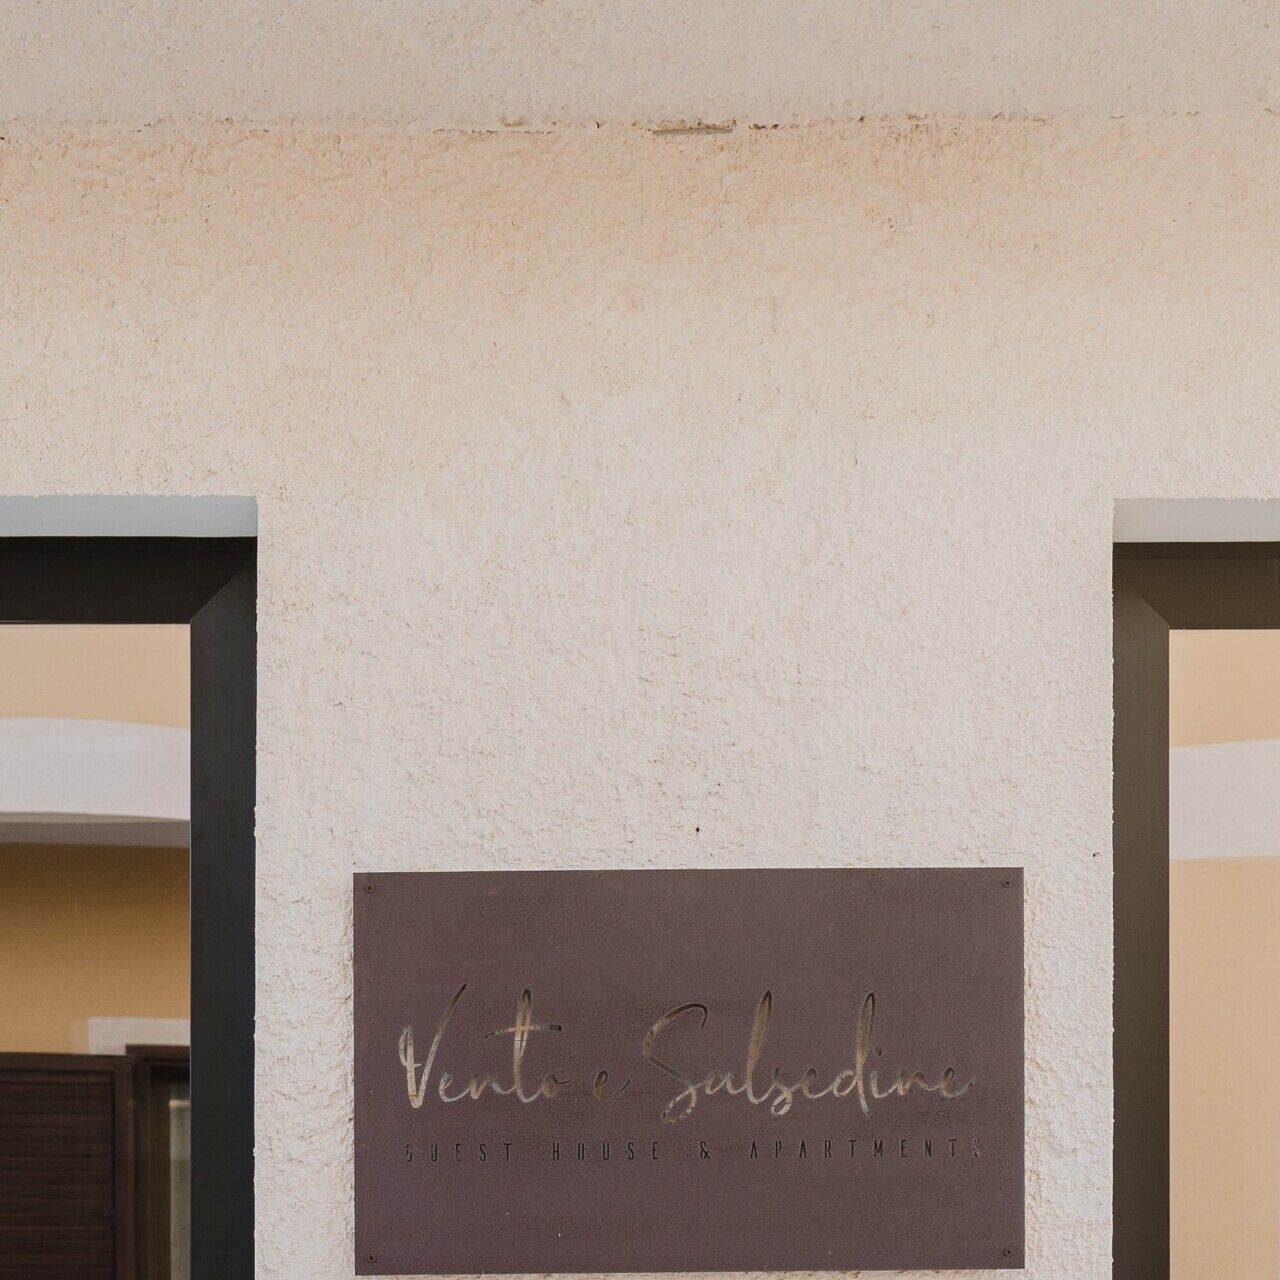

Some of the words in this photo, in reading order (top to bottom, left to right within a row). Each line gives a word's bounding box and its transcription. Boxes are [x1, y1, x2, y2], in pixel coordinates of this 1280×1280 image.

[398, 983, 570, 1110] Vento
[592, 1068, 631, 1101] e
[642, 989, 977, 1124] Salsedine
[406, 1141, 512, 1163] GUEST
[551, 1140, 660, 1162] HOUSE
[698, 1140, 712, 1161] &
[749, 1137, 983, 1160] APARTMENTS
